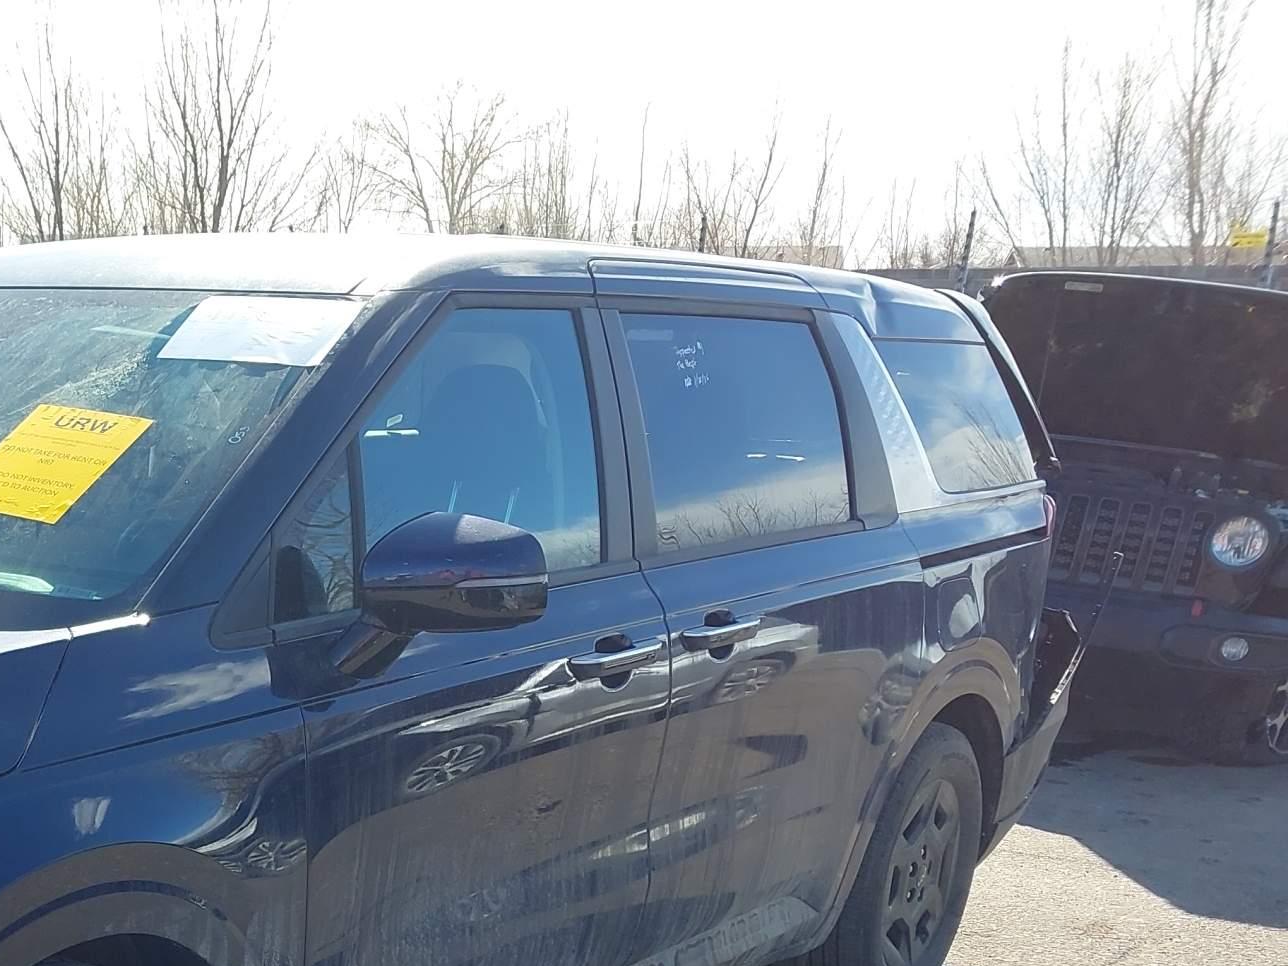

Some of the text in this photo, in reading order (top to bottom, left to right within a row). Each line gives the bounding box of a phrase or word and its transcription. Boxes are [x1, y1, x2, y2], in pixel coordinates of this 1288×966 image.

[54, 414, 119, 434] URW
[10, 472, 28, 482] NOT
[29, 476, 75, 489] INVENTORY
[21, 484, 60, 498] AUCTION
